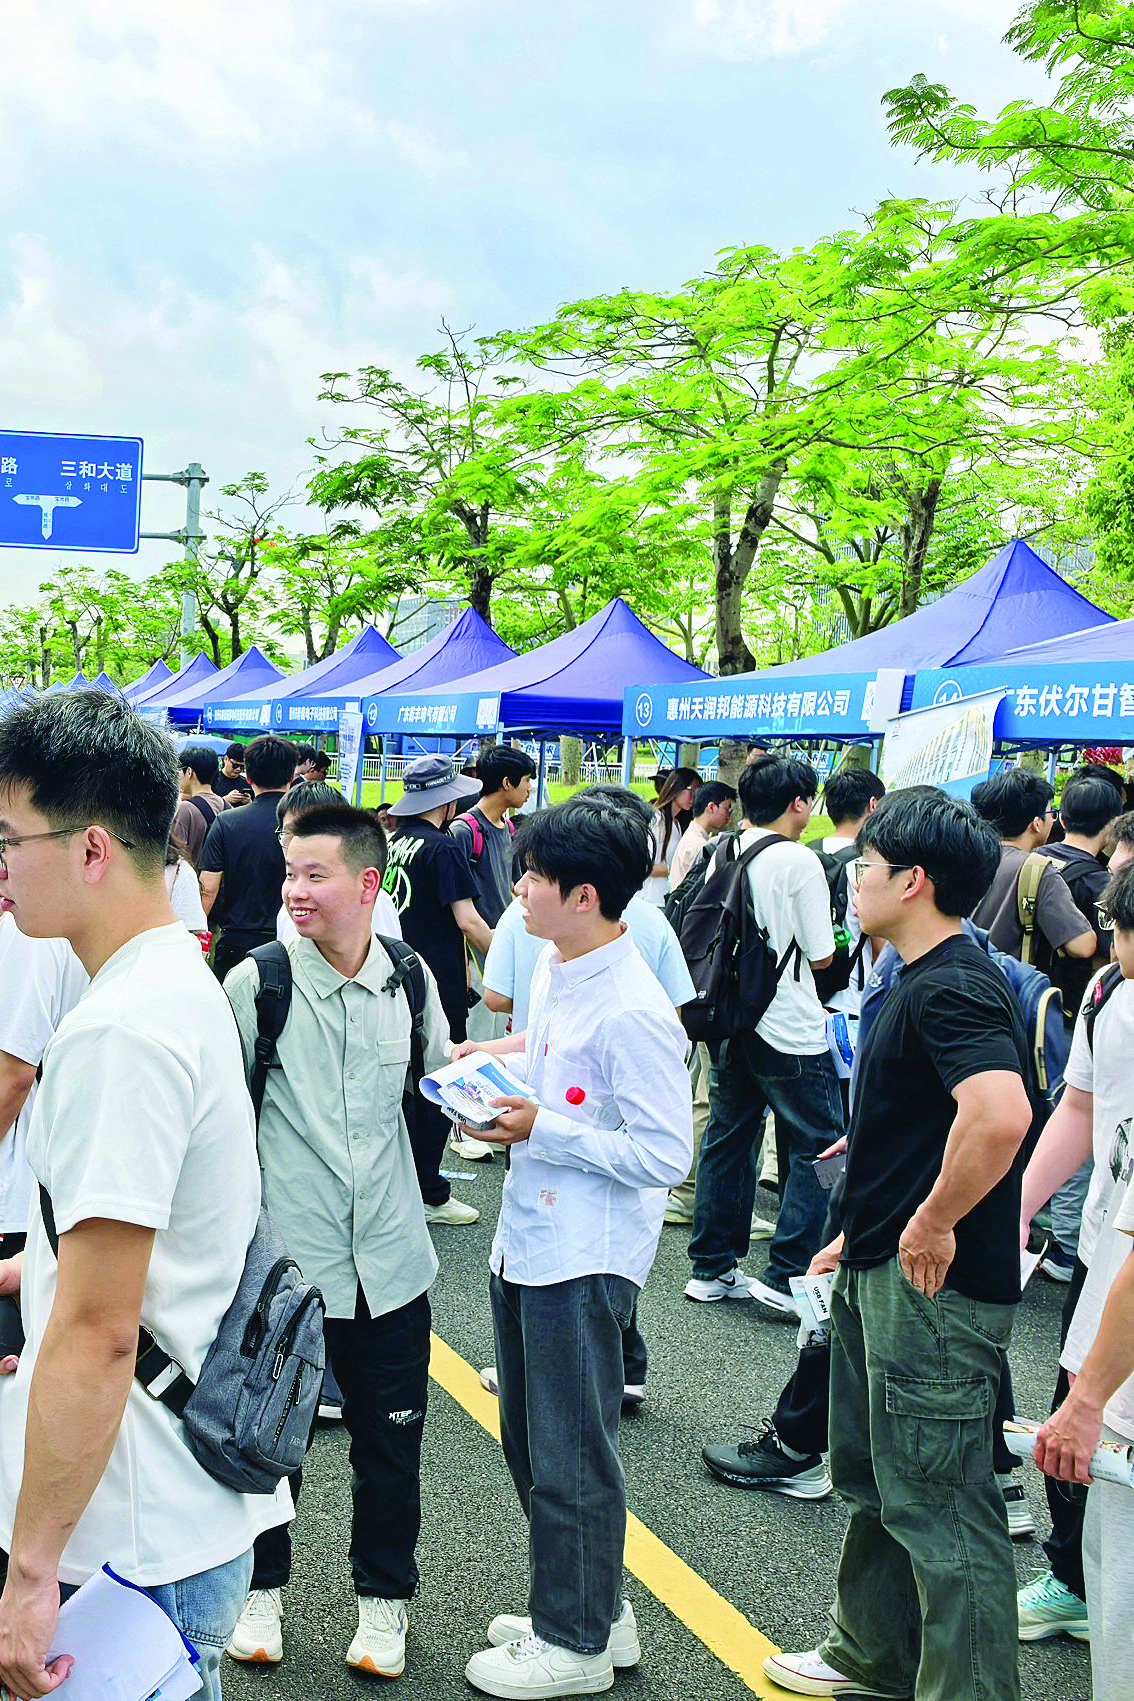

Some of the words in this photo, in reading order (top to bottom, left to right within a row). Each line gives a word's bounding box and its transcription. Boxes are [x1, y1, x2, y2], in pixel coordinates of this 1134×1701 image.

[60, 460, 133, 482] 三和大道
[637, 702, 650, 718] 13
[666, 689, 851, 721] 惠州天润邦能源科技有限公司
[818, 1299, 828, 1314] FAN
